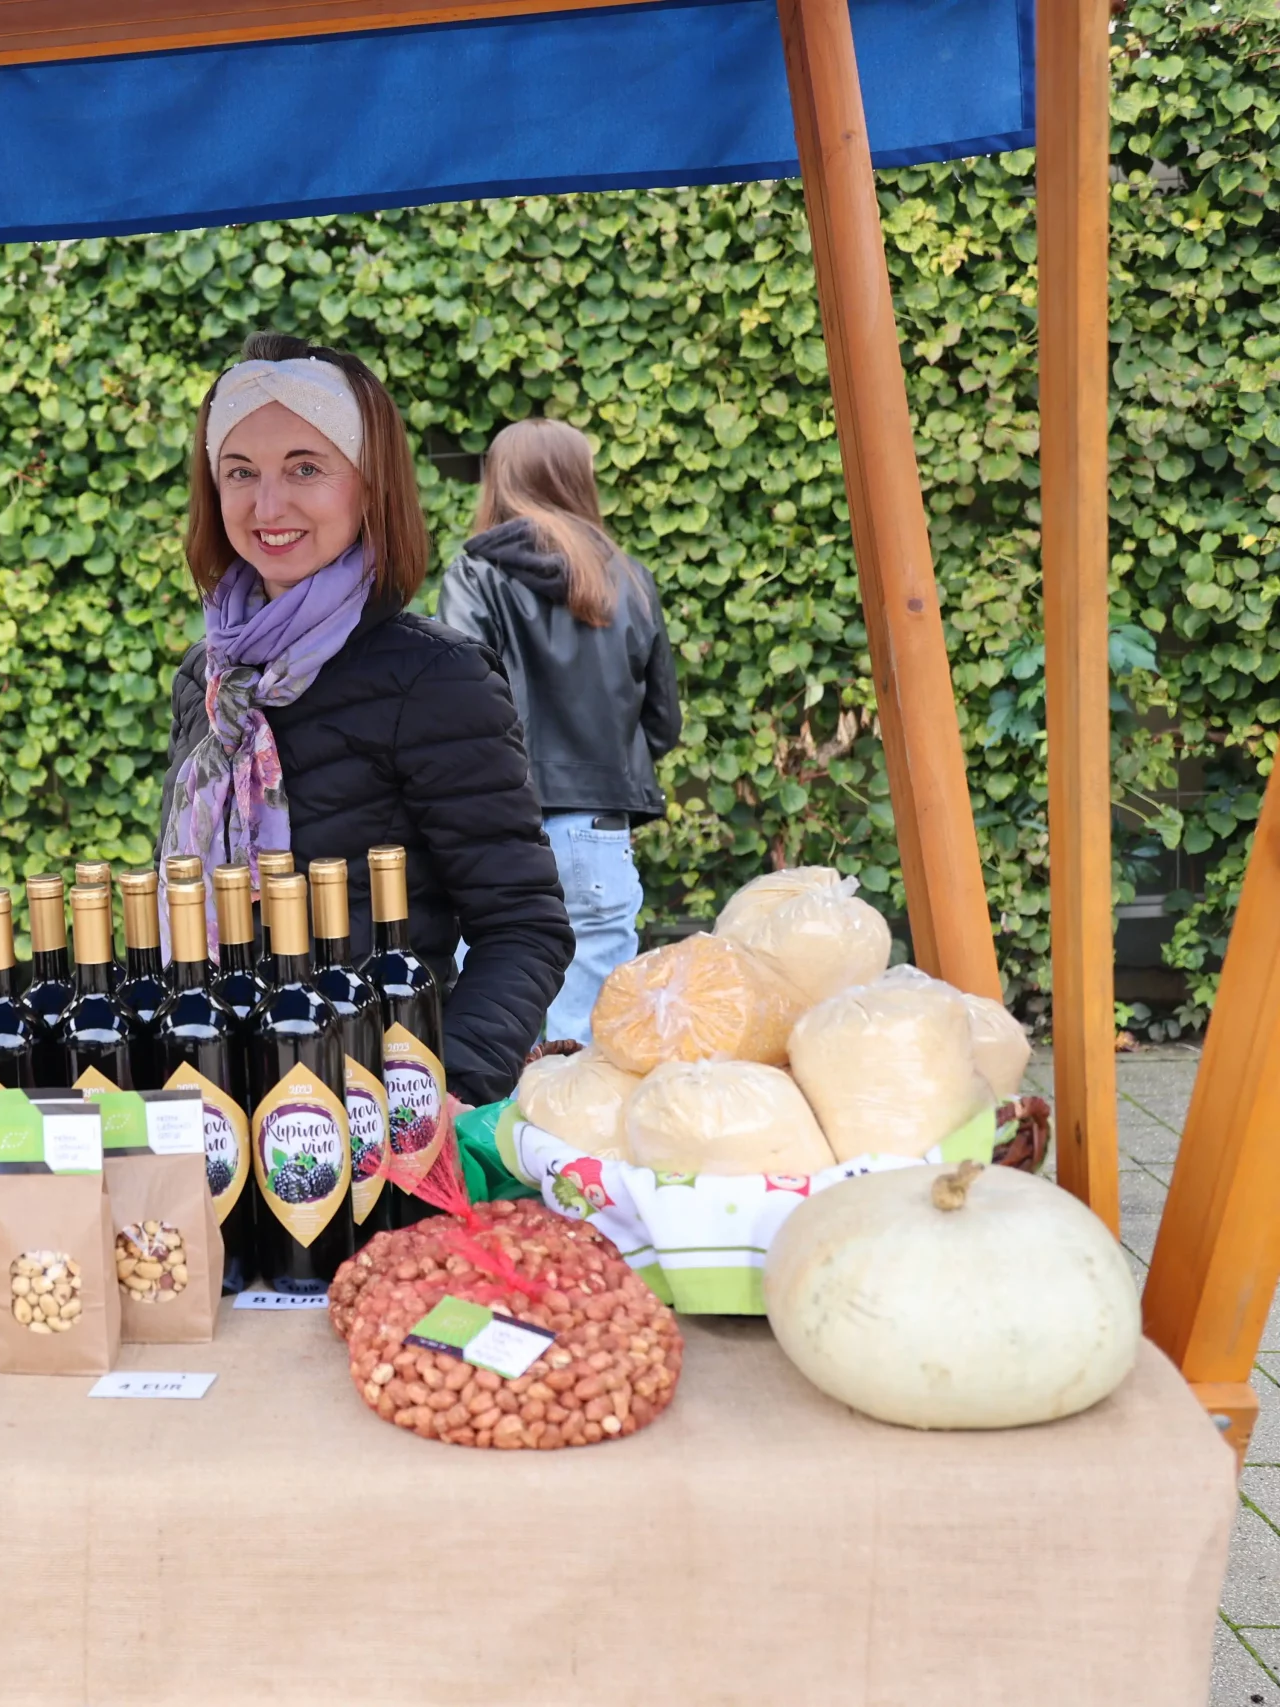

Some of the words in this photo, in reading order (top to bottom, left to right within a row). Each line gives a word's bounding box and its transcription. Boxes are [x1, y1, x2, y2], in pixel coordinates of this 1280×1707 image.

[387, 1042, 410, 1053] 2023
[288, 1084, 313, 1095] 2023
[401, 1093, 432, 1108] vino
[302, 1139, 335, 1154] vino
[276, 1296, 325, 1304] EUR
[142, 1383, 183, 1391] EUR
